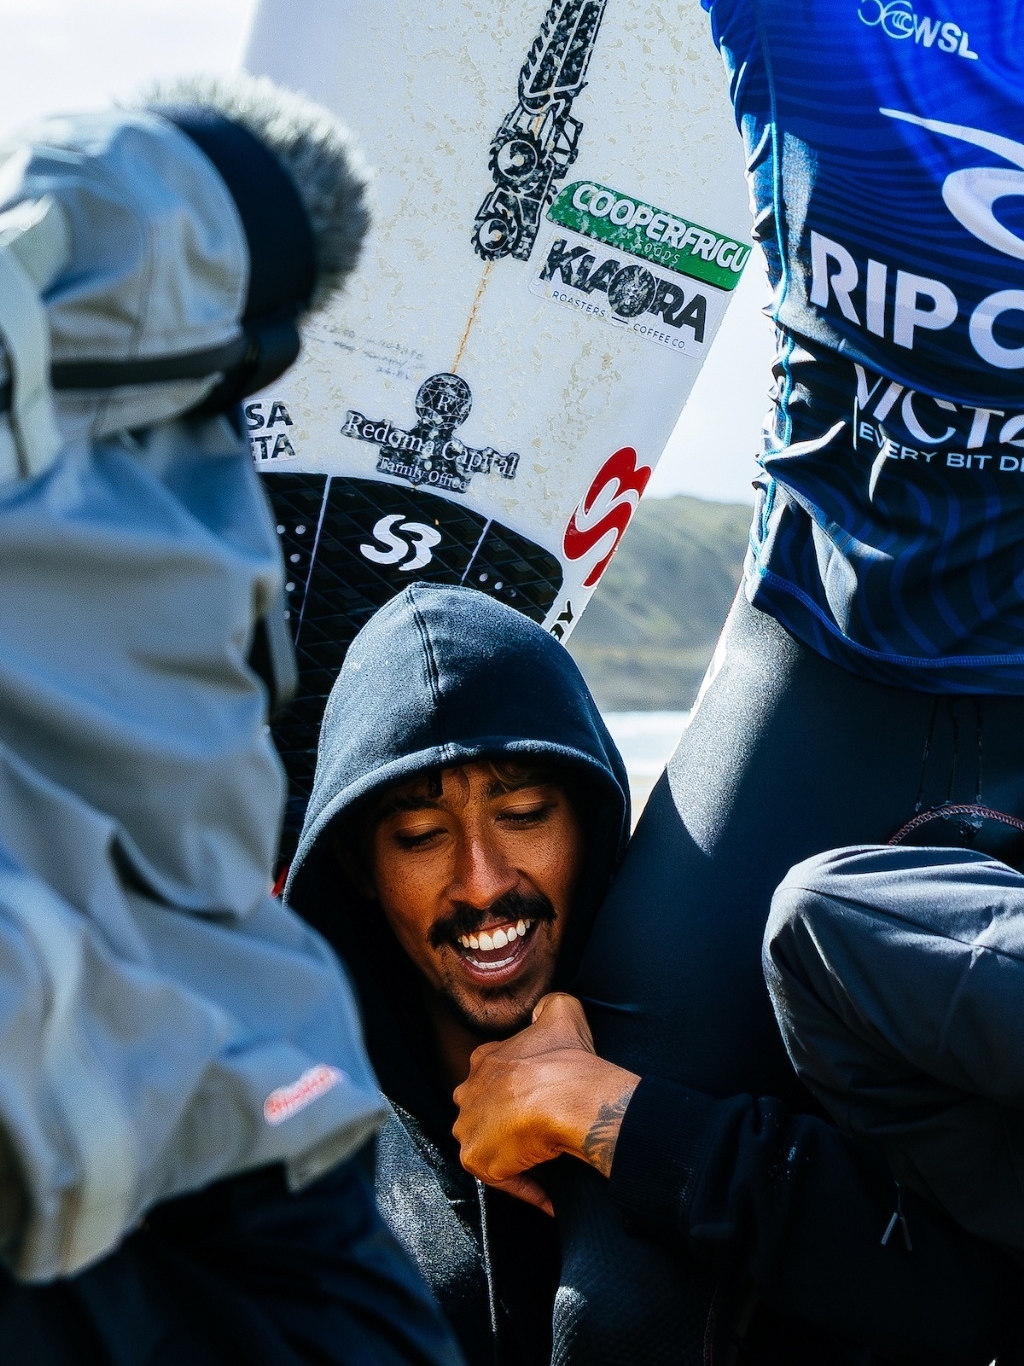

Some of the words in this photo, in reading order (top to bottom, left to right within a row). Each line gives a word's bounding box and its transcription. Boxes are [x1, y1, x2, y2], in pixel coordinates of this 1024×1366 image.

[809, 229, 959, 351] RIP
[552, 290, 606, 317] ROASTERS
[633, 323, 672, 345] COFFEE
[250, 433, 296, 460] TA
[346, 413, 436, 454] Redoma
[441, 441, 516, 477] Capital
[858, 421, 939, 463] EVERY
[946, 452, 993, 470] BIT
[380, 457, 426, 480] Family
[428, 470, 468, 491] Office
